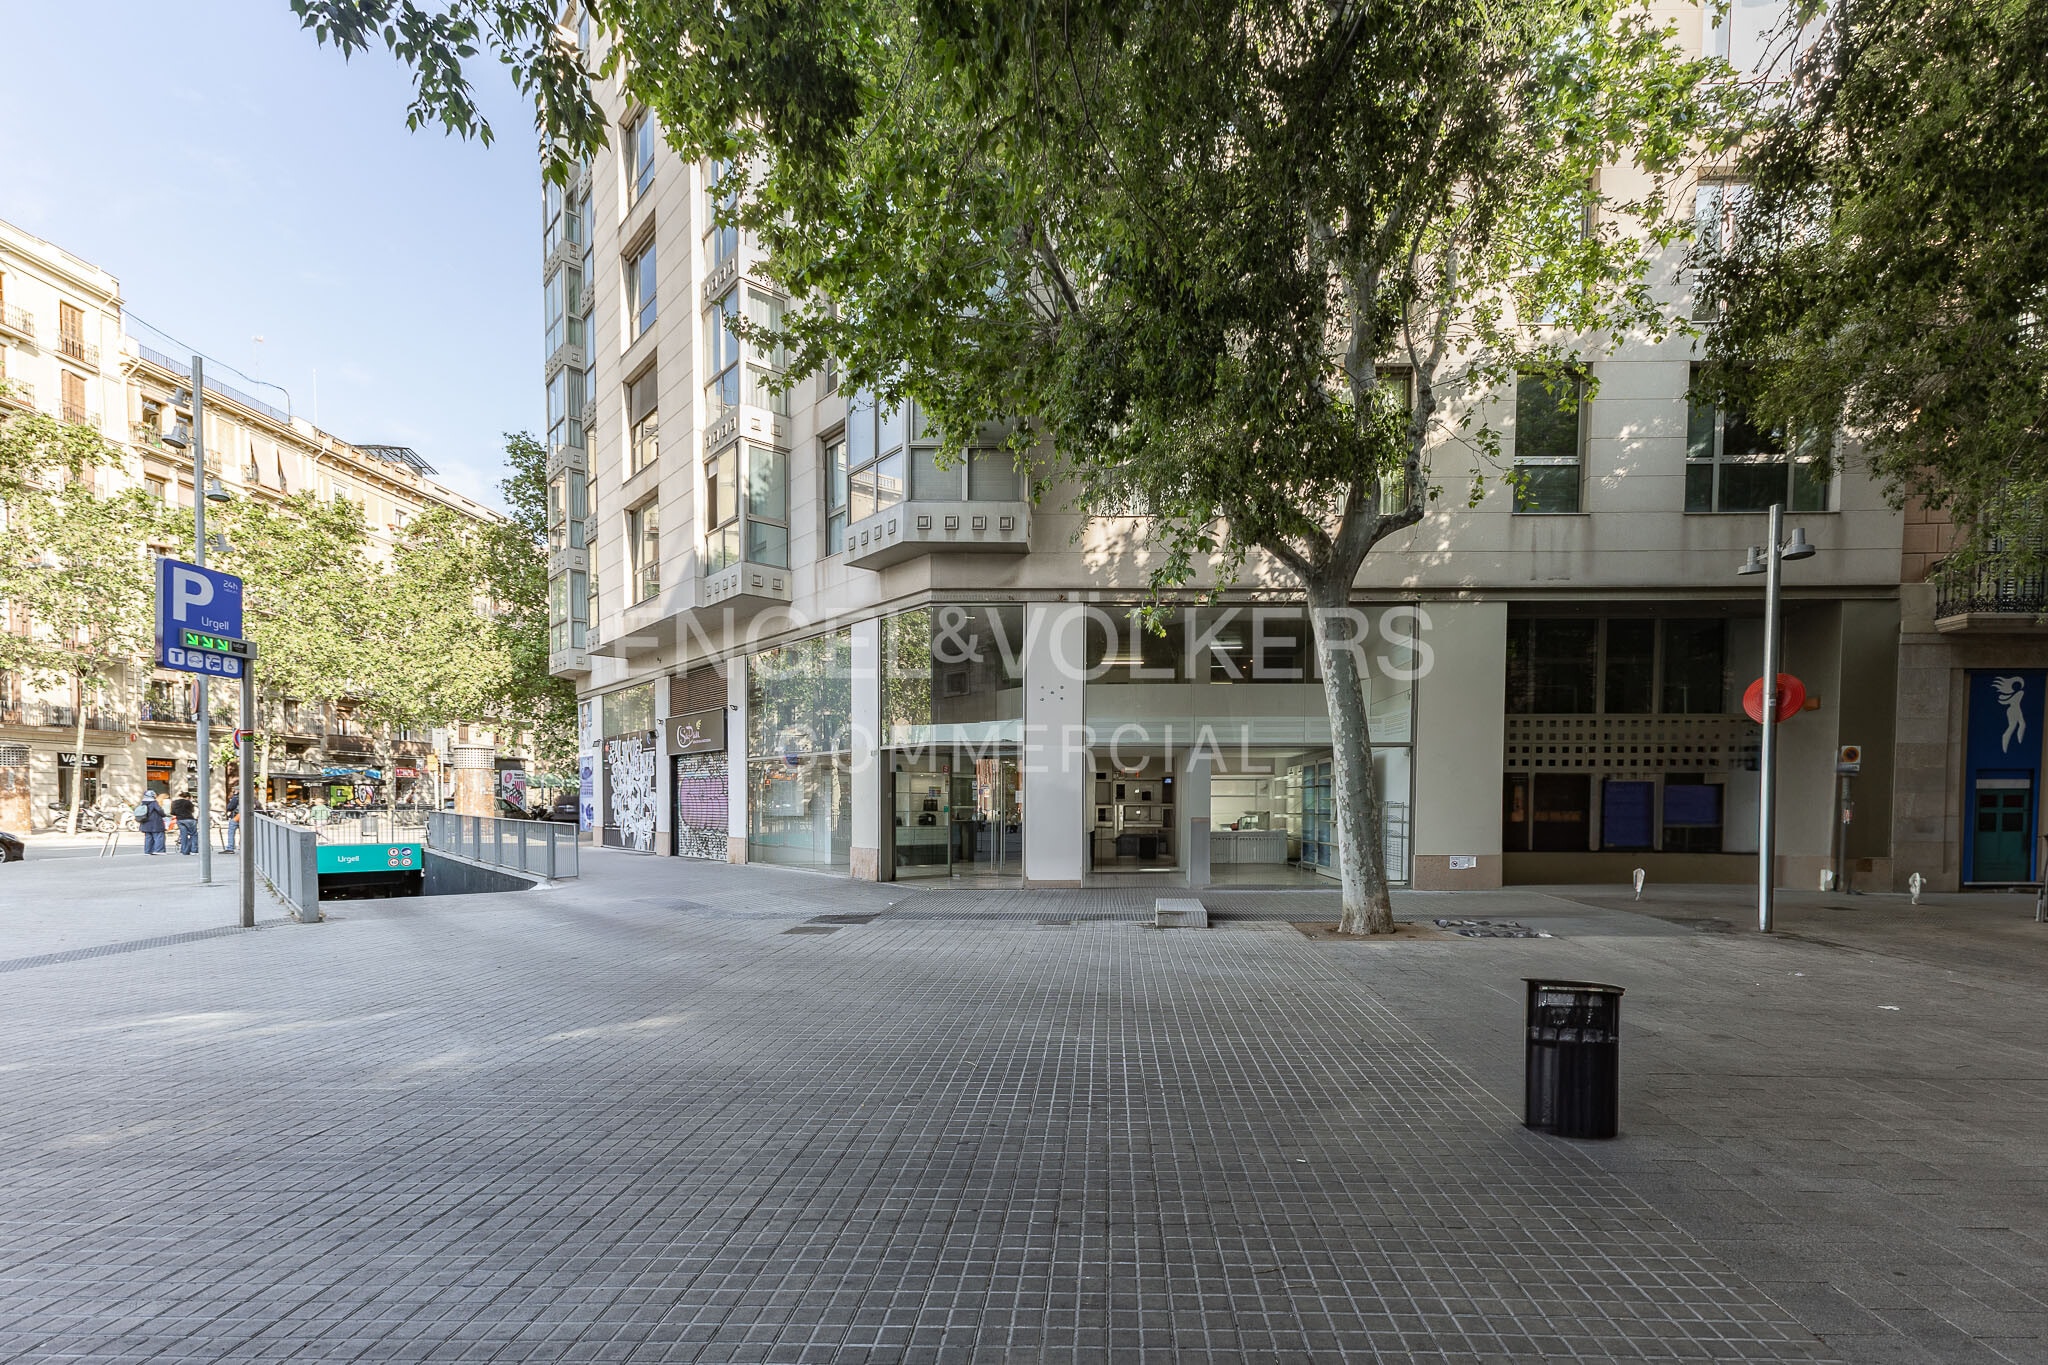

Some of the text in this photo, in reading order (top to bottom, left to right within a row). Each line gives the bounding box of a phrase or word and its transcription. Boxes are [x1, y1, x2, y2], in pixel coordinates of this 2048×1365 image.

[223, 580, 238, 590] 24h
[173, 567, 214, 622] P
[201, 616, 229, 631] Urgell
[61, 753, 98, 764] VALS
